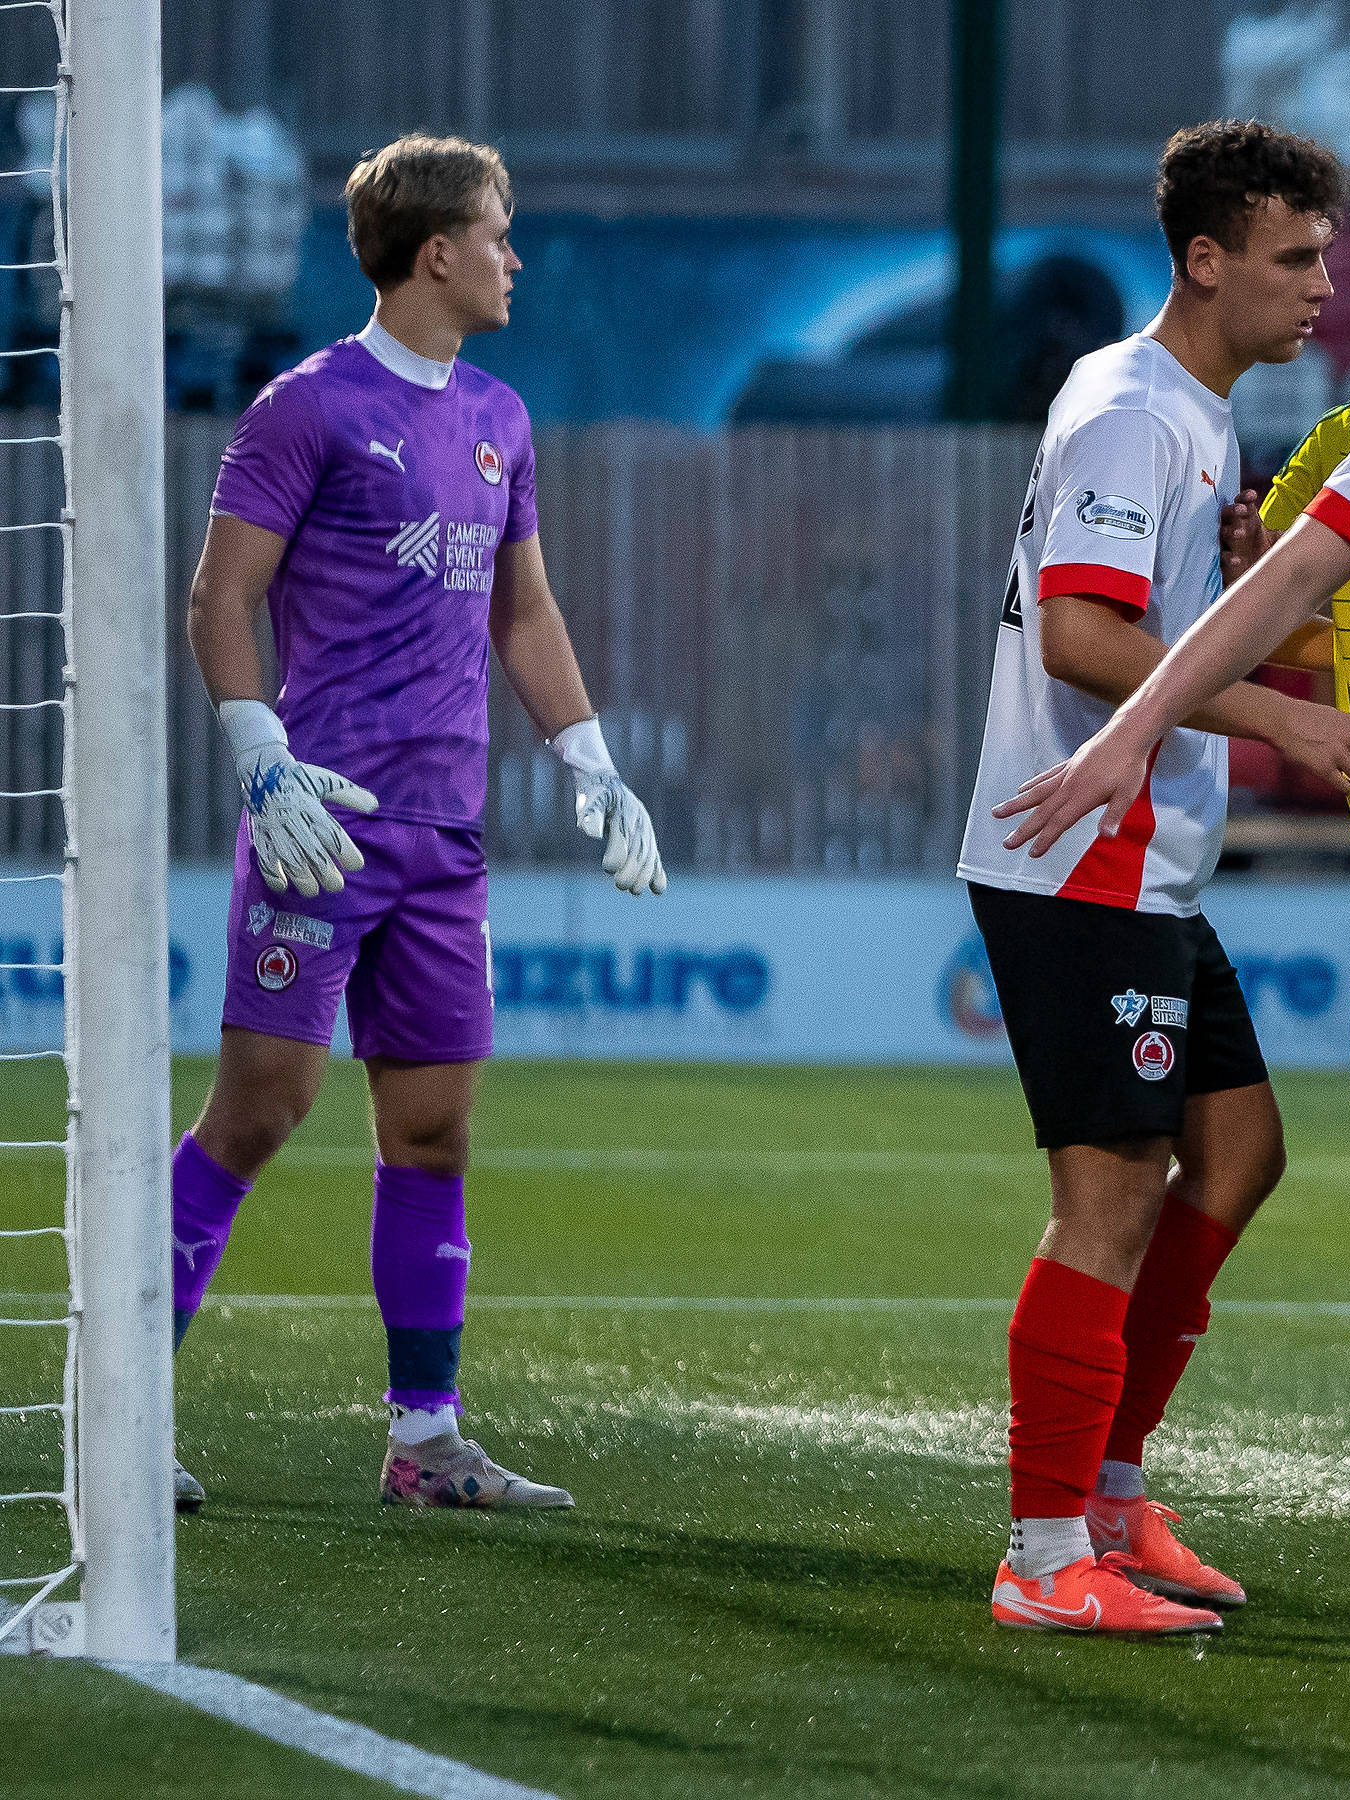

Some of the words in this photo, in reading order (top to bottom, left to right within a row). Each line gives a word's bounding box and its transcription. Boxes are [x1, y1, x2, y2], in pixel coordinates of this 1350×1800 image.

[1126, 510, 1147, 525] HILL
[447, 520, 498, 548] CAMERON
[446, 544, 485, 569] EVENT
